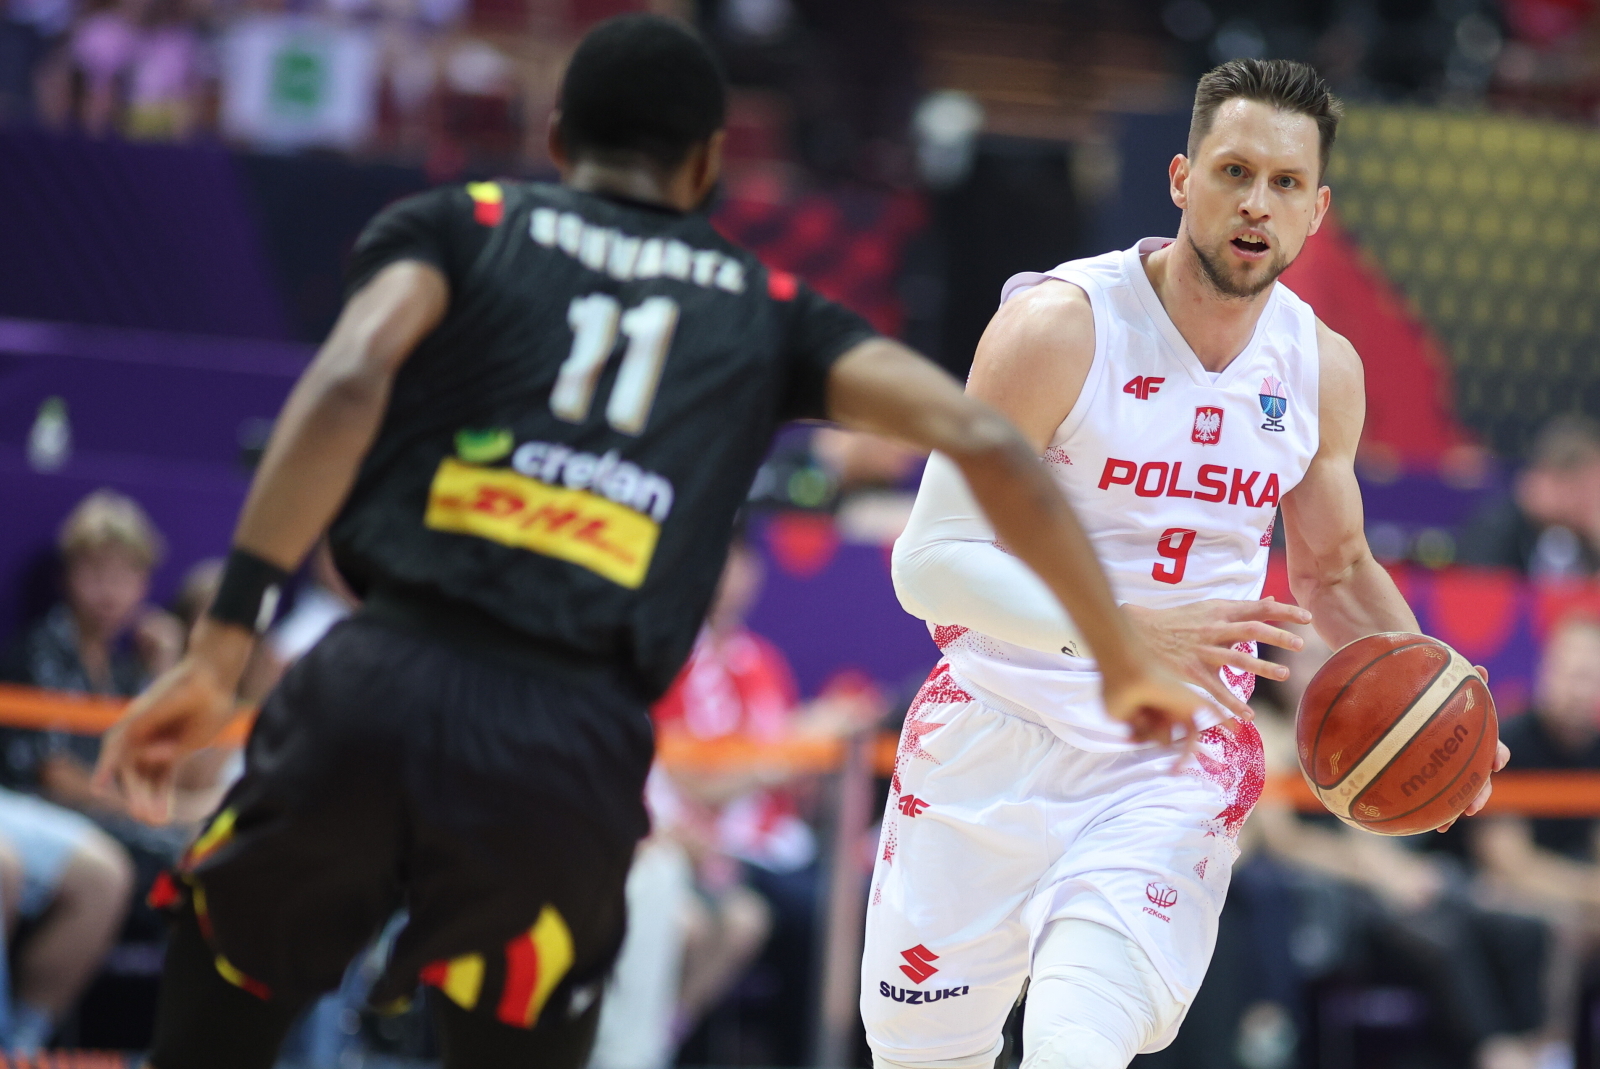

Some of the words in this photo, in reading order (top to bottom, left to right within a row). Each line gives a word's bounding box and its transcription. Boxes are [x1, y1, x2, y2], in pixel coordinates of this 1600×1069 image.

[549, 293, 680, 437] 11
[1123, 375, 1165, 400] 4F
[511, 440, 675, 523] crelan
[1098, 457, 1279, 508] POLSKA
[471, 484, 617, 551] DHL
[1151, 528, 1197, 585] 9
[1400, 724, 1468, 797] molten
[1447, 772, 1481, 808] FIBA
[879, 981, 969, 1005] SUZUKI
